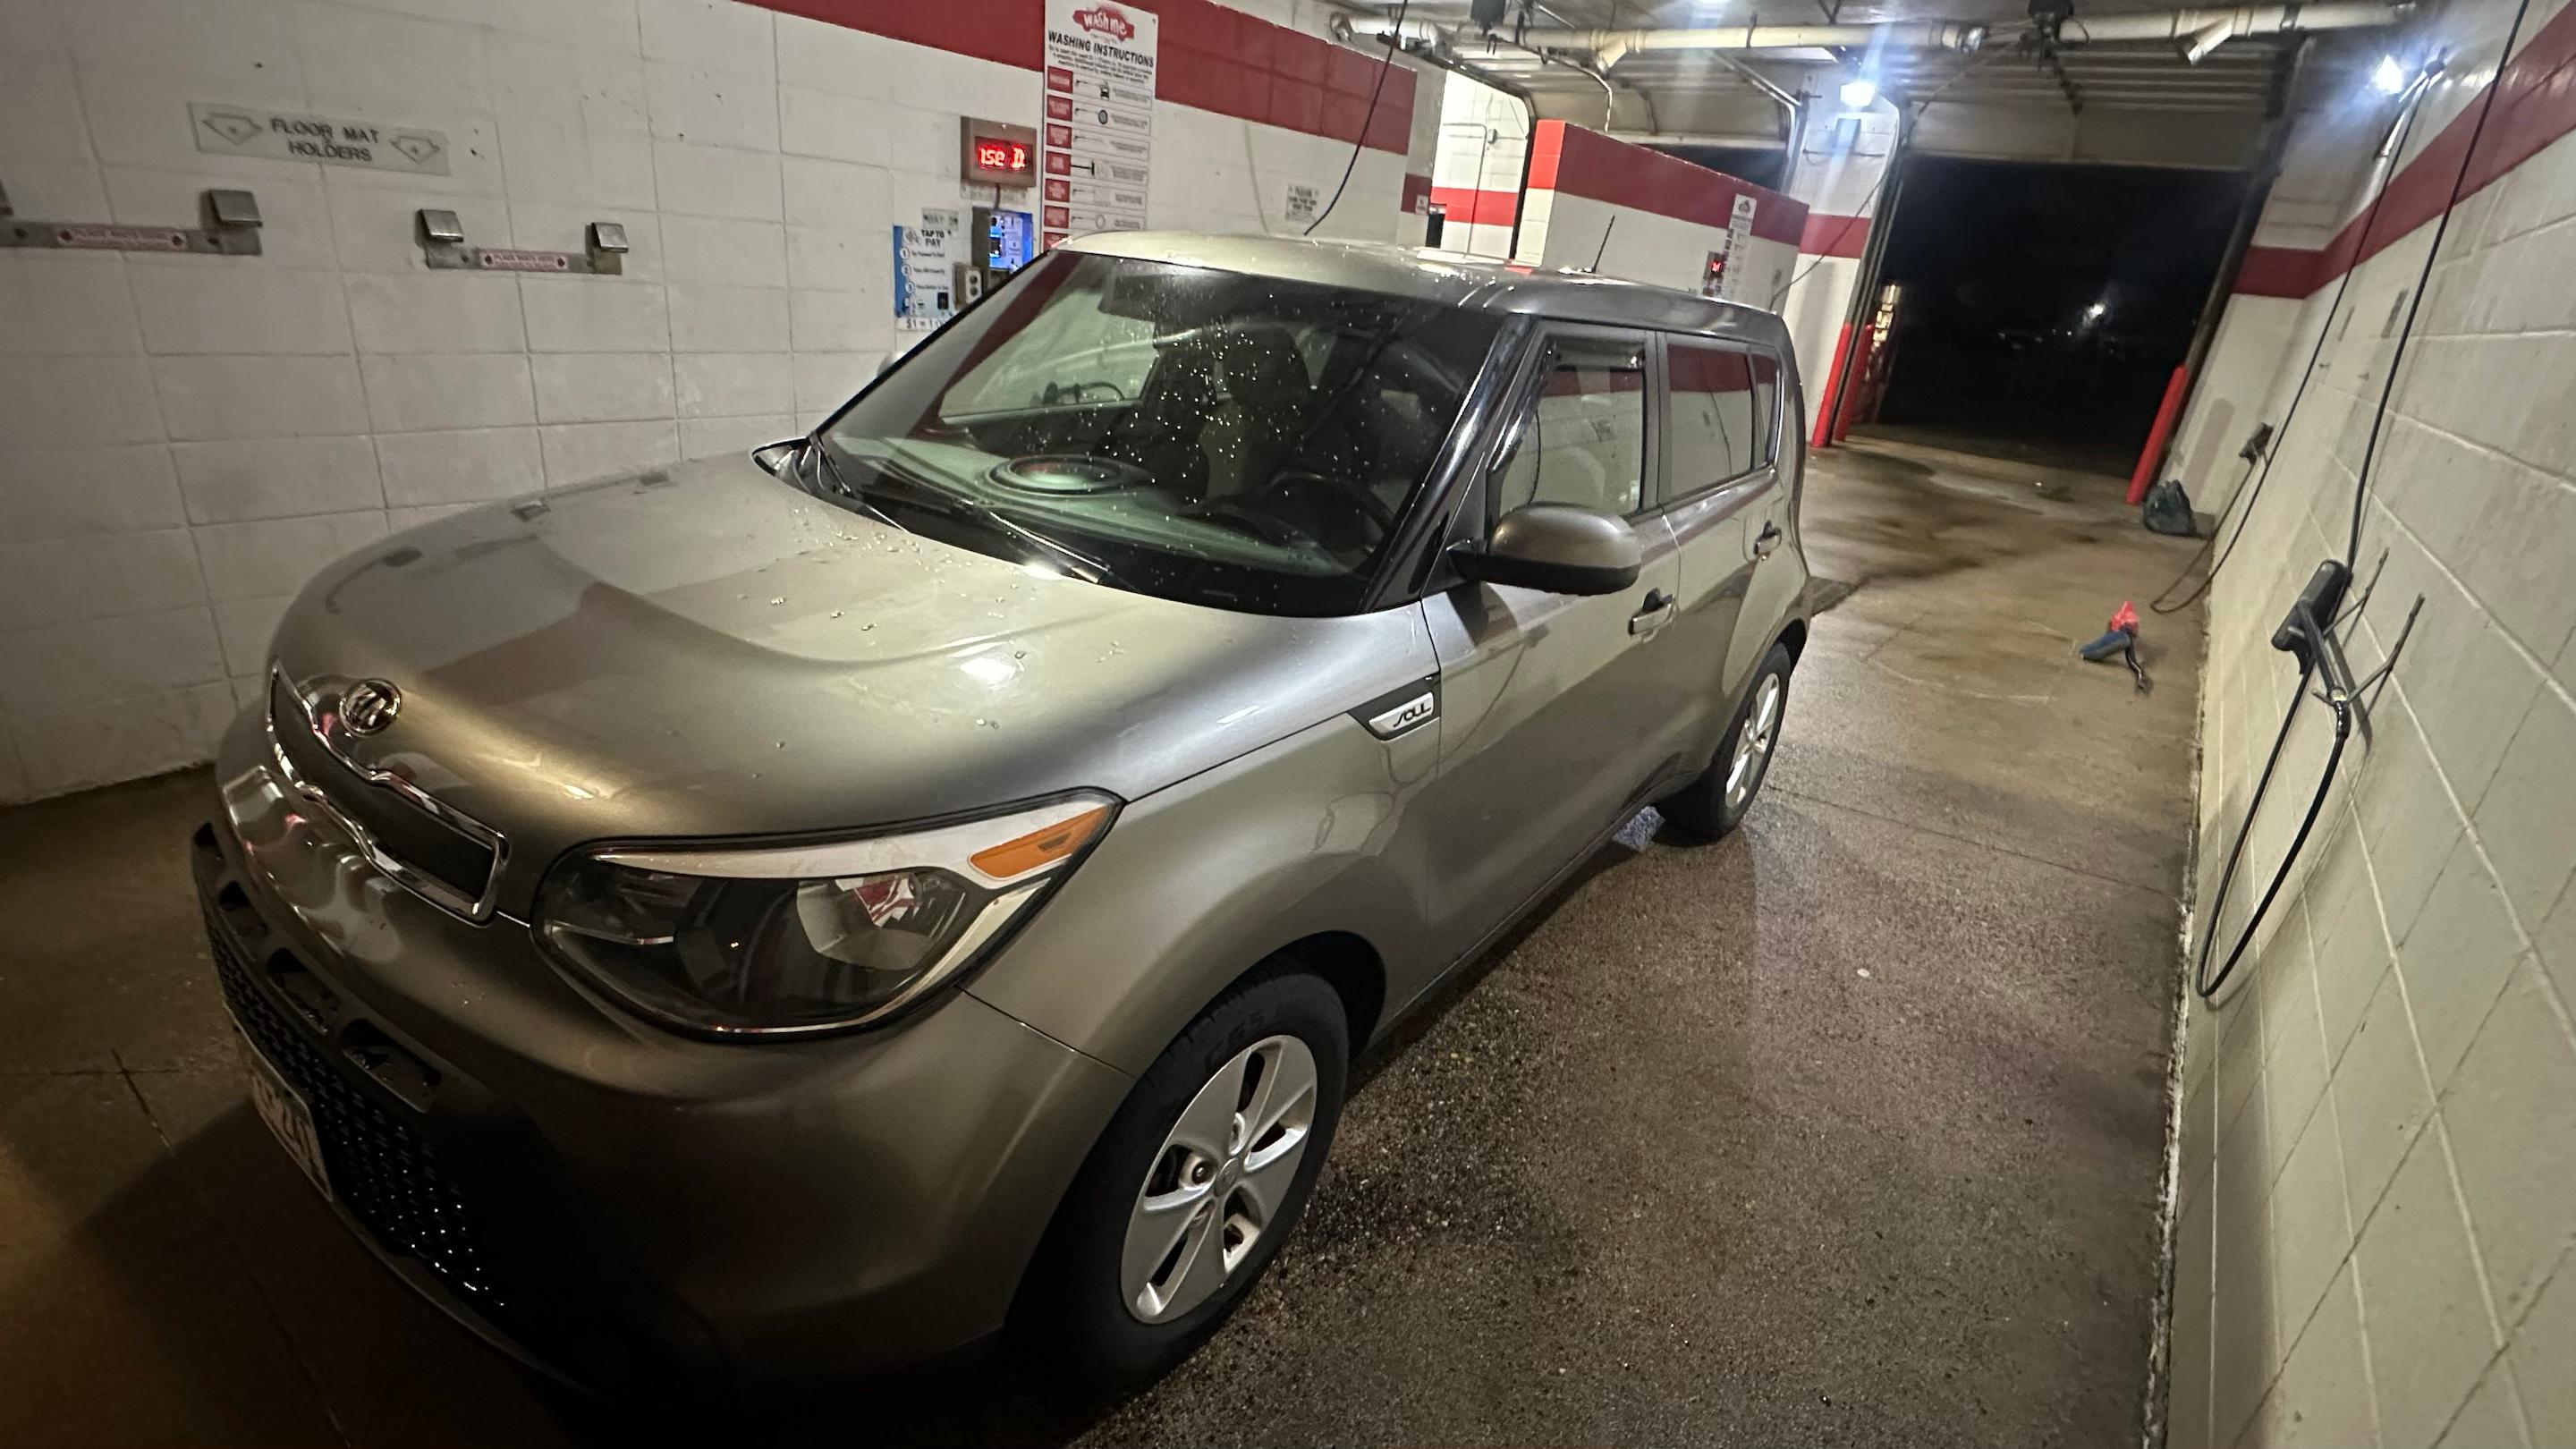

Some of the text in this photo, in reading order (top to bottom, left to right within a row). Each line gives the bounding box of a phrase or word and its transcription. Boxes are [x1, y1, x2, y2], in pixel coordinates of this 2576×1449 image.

[1048, 30, 1091, 52] WASHING
[1093, 42, 1154, 69] INSTRUCTIONS
[271, 118, 379, 144] FLOOR MAT
[287, 140, 373, 161] HOLDERS
[921, 229, 945, 239] TAP TO
[925, 238, 941, 248] PAY
[1393, 703, 1432, 728] SOUL
